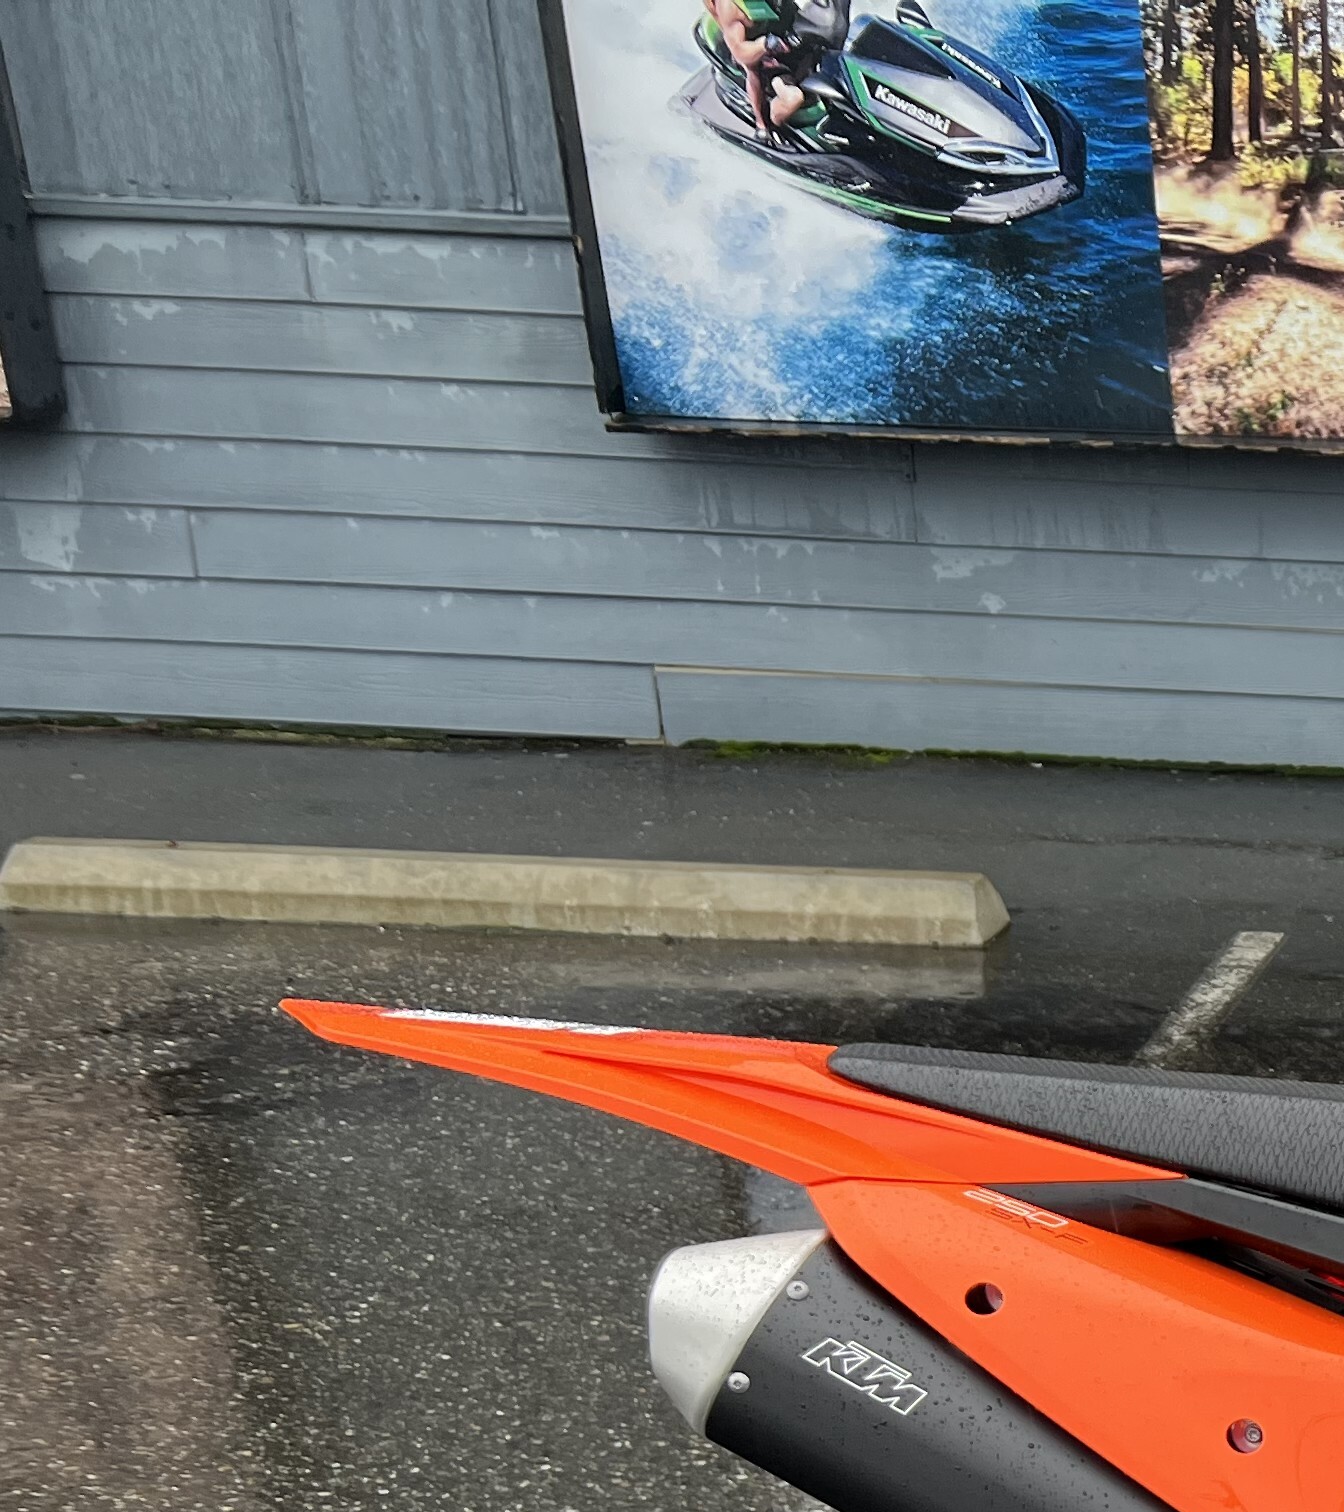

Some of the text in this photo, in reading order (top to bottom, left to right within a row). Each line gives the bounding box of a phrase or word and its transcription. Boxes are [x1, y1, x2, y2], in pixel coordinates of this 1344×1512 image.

[874, 84, 951, 135] Kawasaki
[962, 1187, 1069, 1229] 250
[985, 1207, 1089, 1245] SX-F
[801, 1337, 929, 1416] KTM
